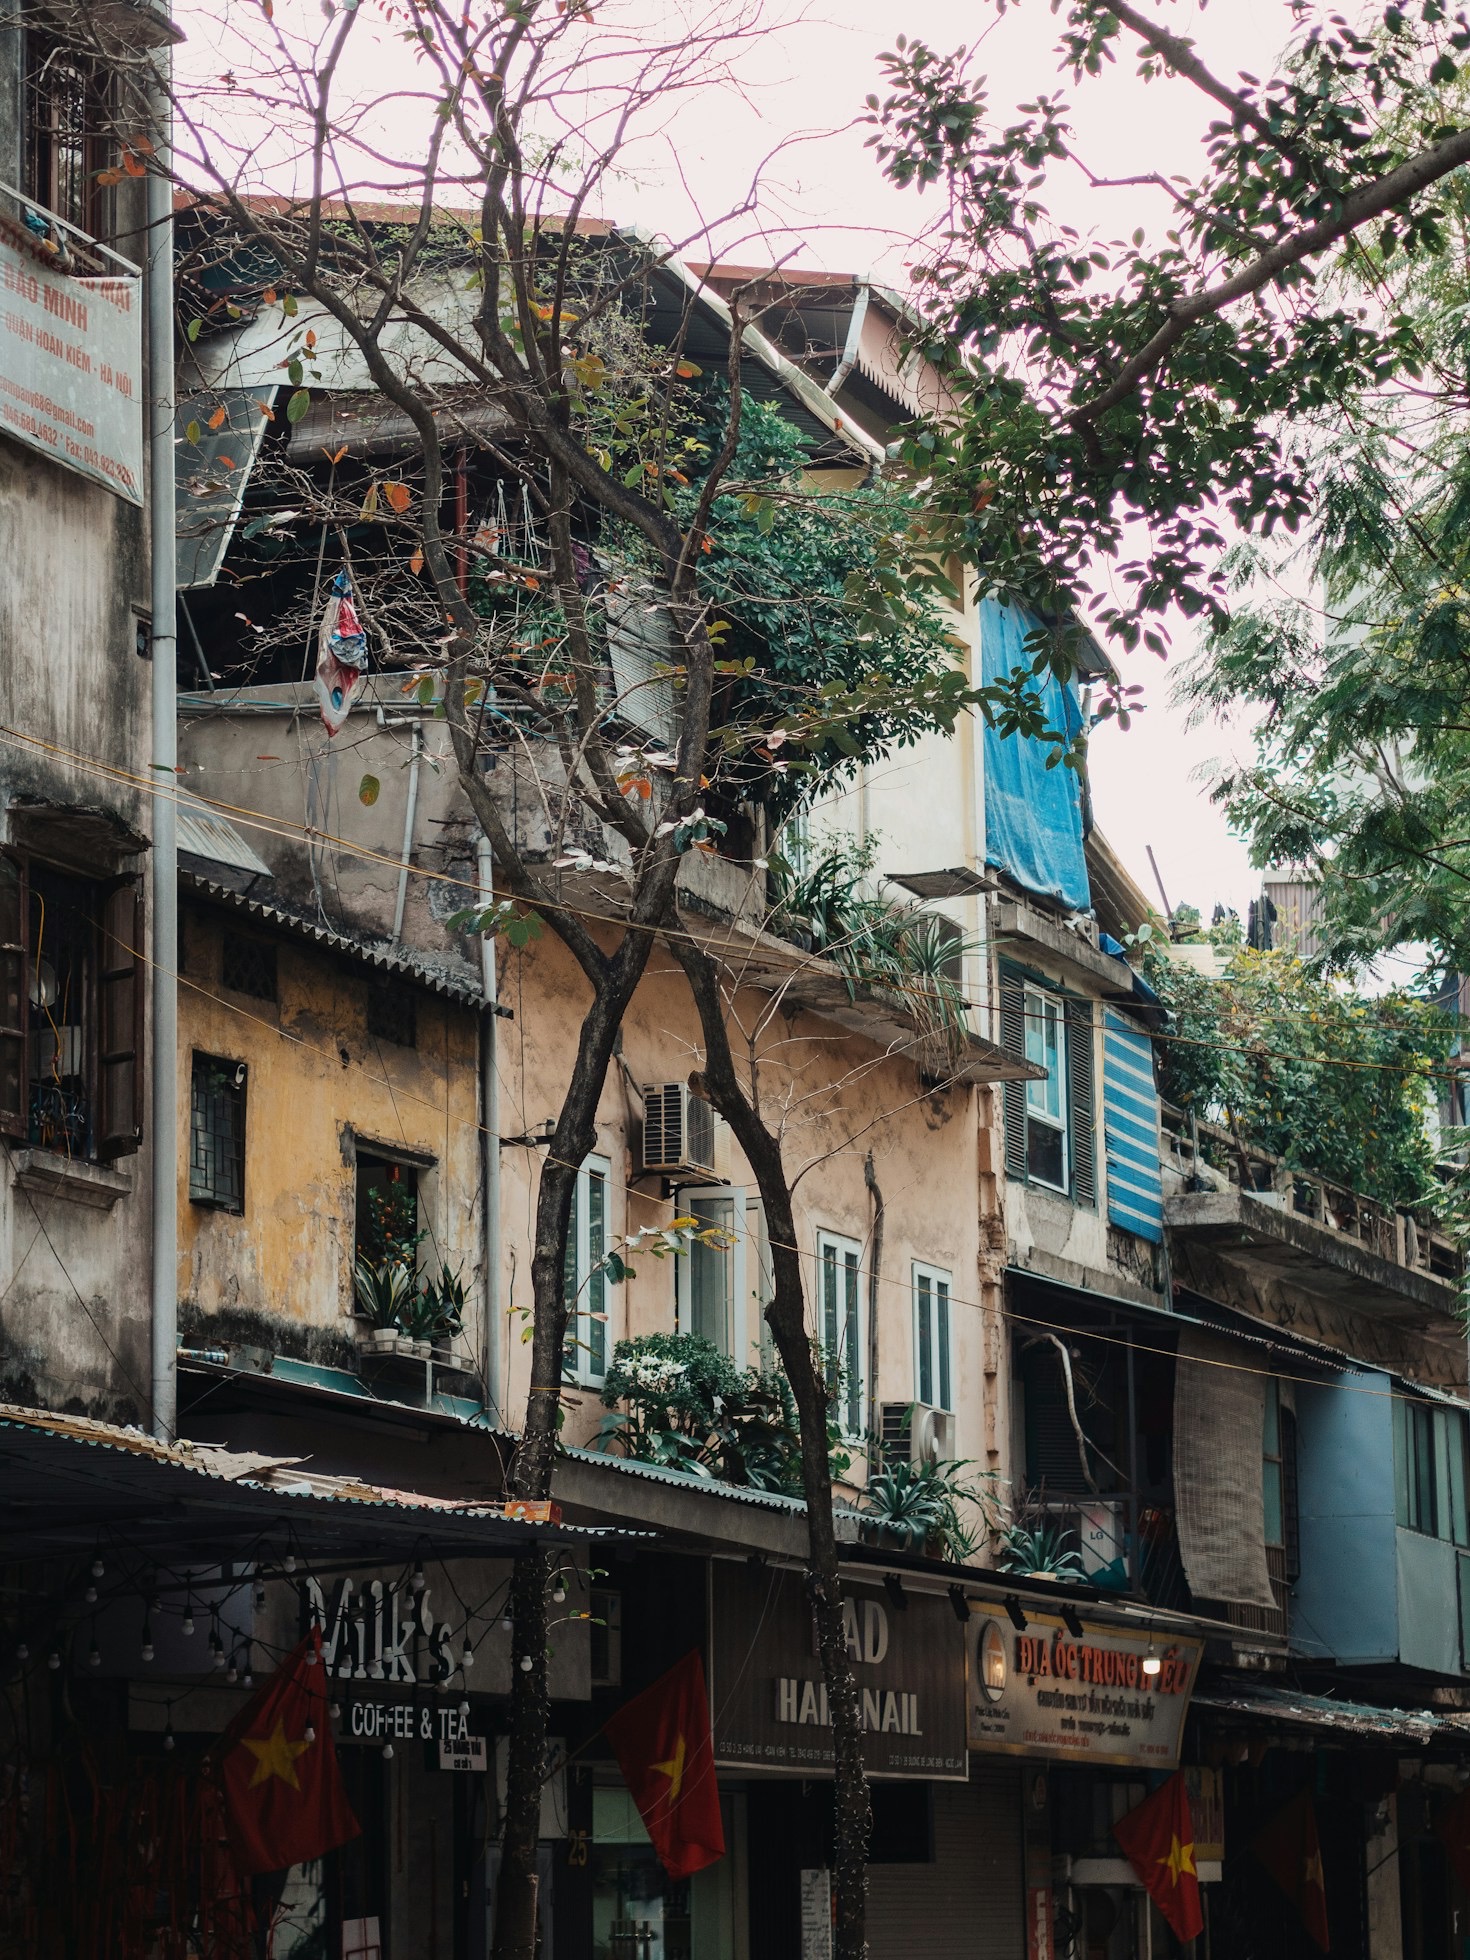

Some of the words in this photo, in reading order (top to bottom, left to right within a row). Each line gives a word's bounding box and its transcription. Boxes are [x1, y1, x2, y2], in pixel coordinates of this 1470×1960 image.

[44, 283, 88, 332] MINH
[36, 327, 63, 359] HOÀN
[100, 362, 113, 387] HÀ
[115, 371, 132, 399] NỘI
[1090, 1531, 1104, 1540] LG
[1020, 1635, 1052, 1686] ĐỊA
[1081, 1644, 1138, 1689] TRUNG
[352, 1702, 414, 1738] COFFEE
[420, 1707, 433, 1739] &
[438, 1708, 469, 1740] TEA
[779, 1677, 834, 1727] HAI
[863, 1687, 923, 1736] NAIL
[568, 1828, 588, 1867] 25
